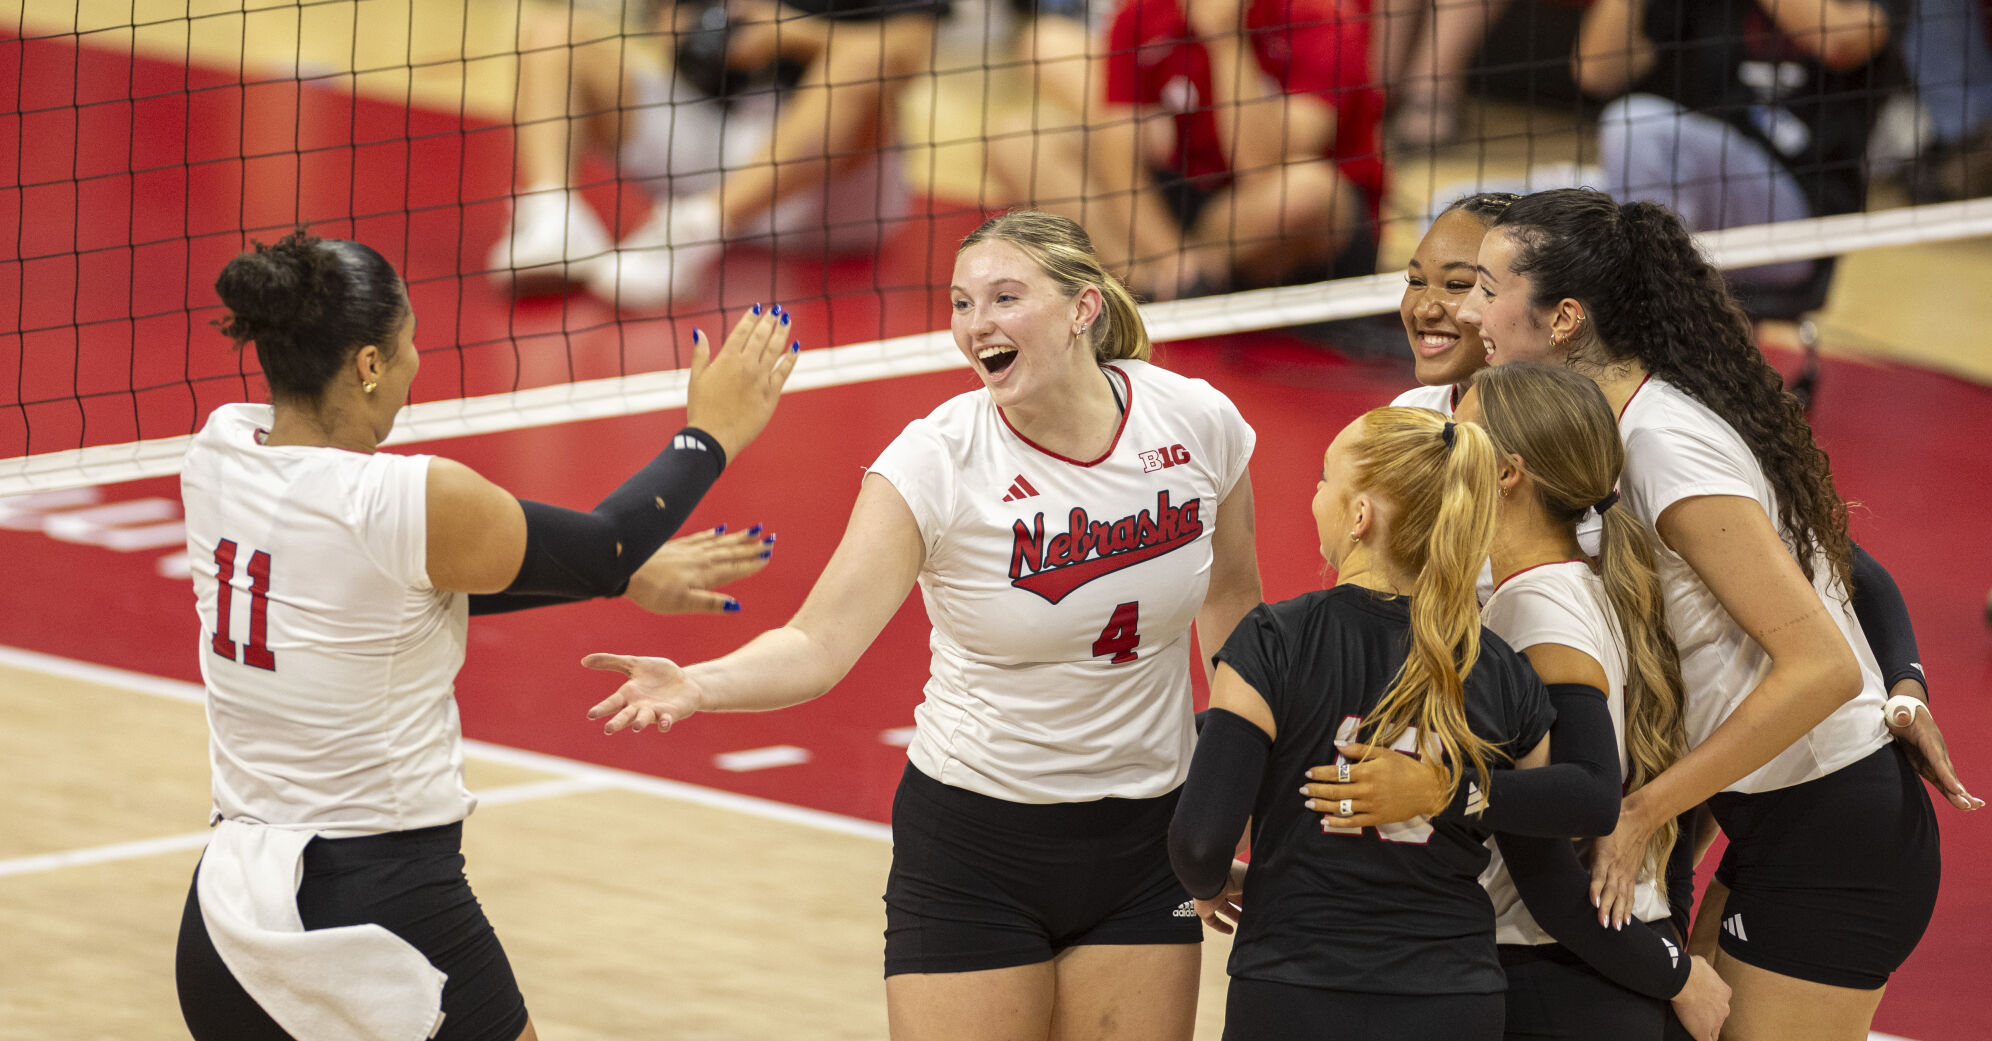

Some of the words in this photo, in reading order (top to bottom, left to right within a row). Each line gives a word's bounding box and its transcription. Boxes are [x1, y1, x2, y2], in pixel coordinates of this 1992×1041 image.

[1008, 489, 1203, 579] Nebraska
[211, 537, 276, 672] 11
[1092, 600, 1141, 664] 4
